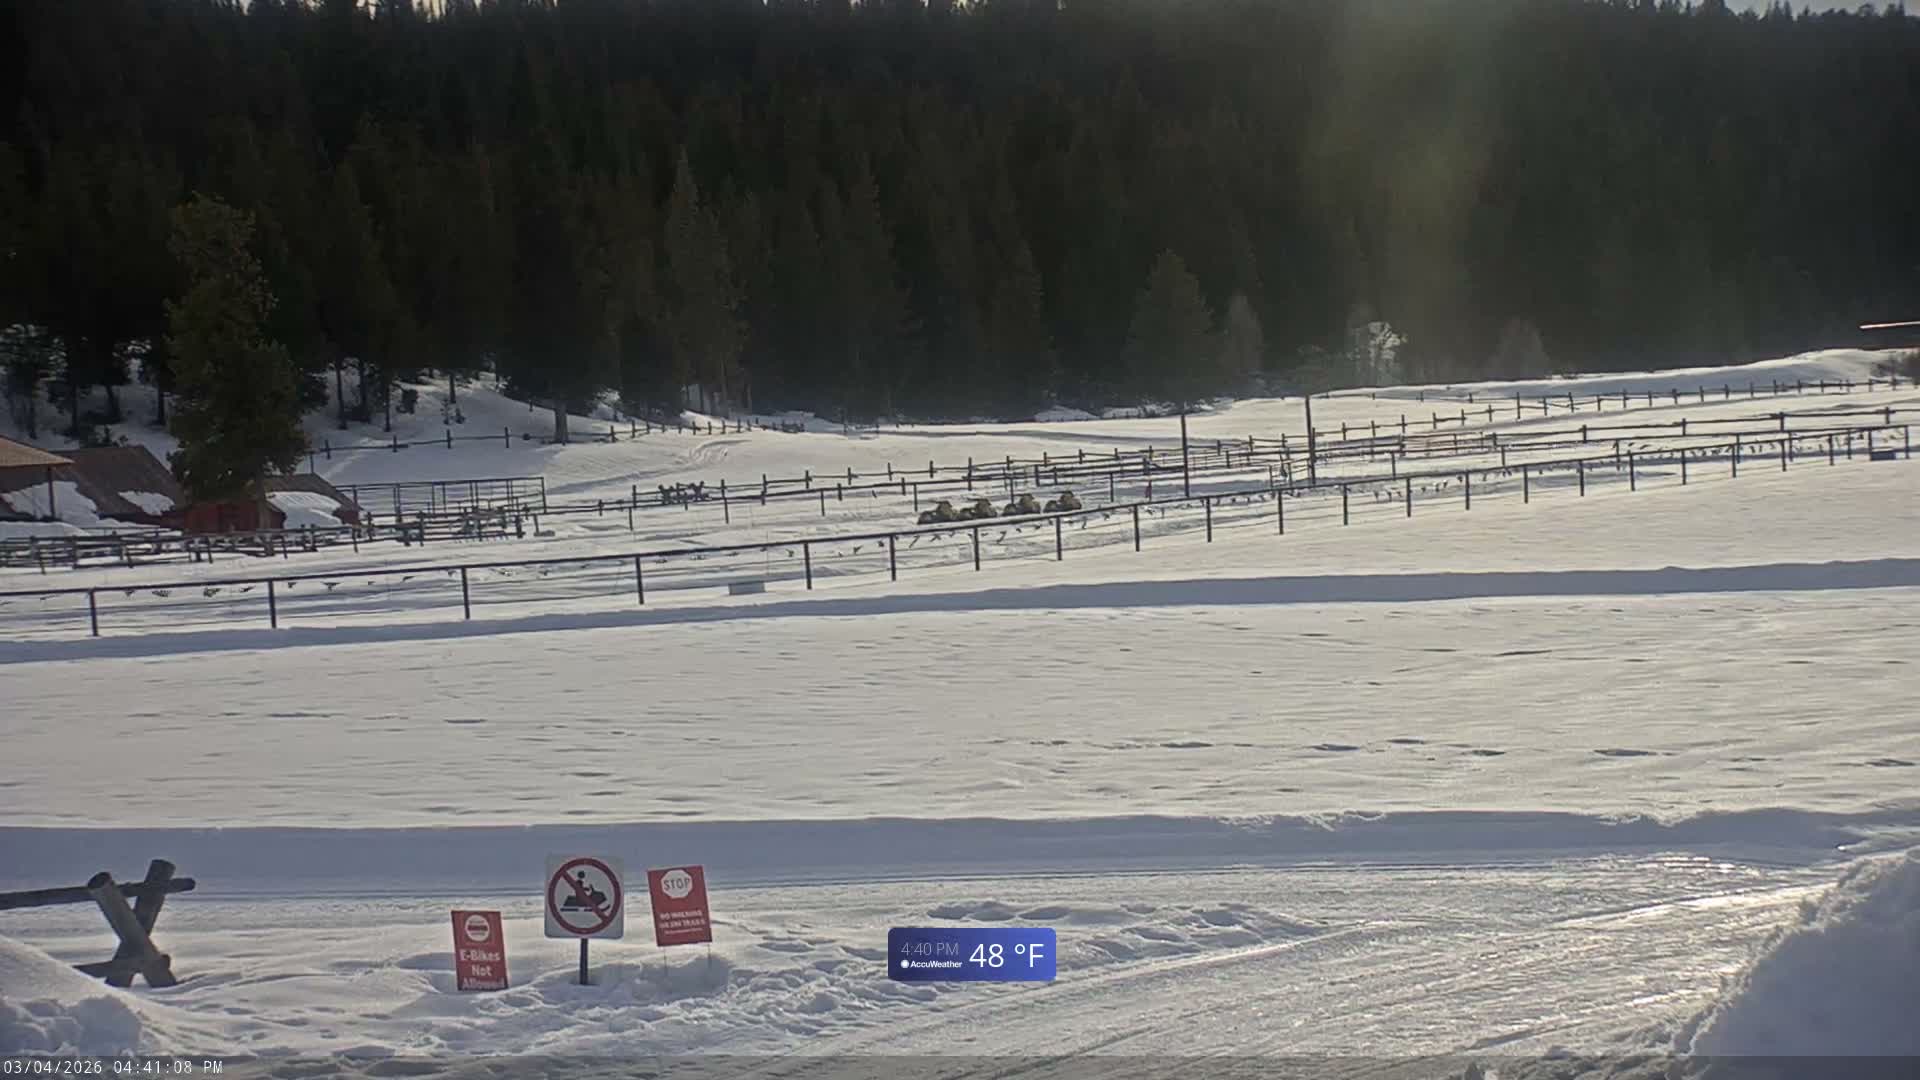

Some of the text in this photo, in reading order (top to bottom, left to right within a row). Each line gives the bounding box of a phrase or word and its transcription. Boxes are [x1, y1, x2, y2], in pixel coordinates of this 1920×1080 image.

[663, 877, 690, 891] STOP
[459, 948, 501, 961] E-Bikes
[471, 964, 493, 977] Not
